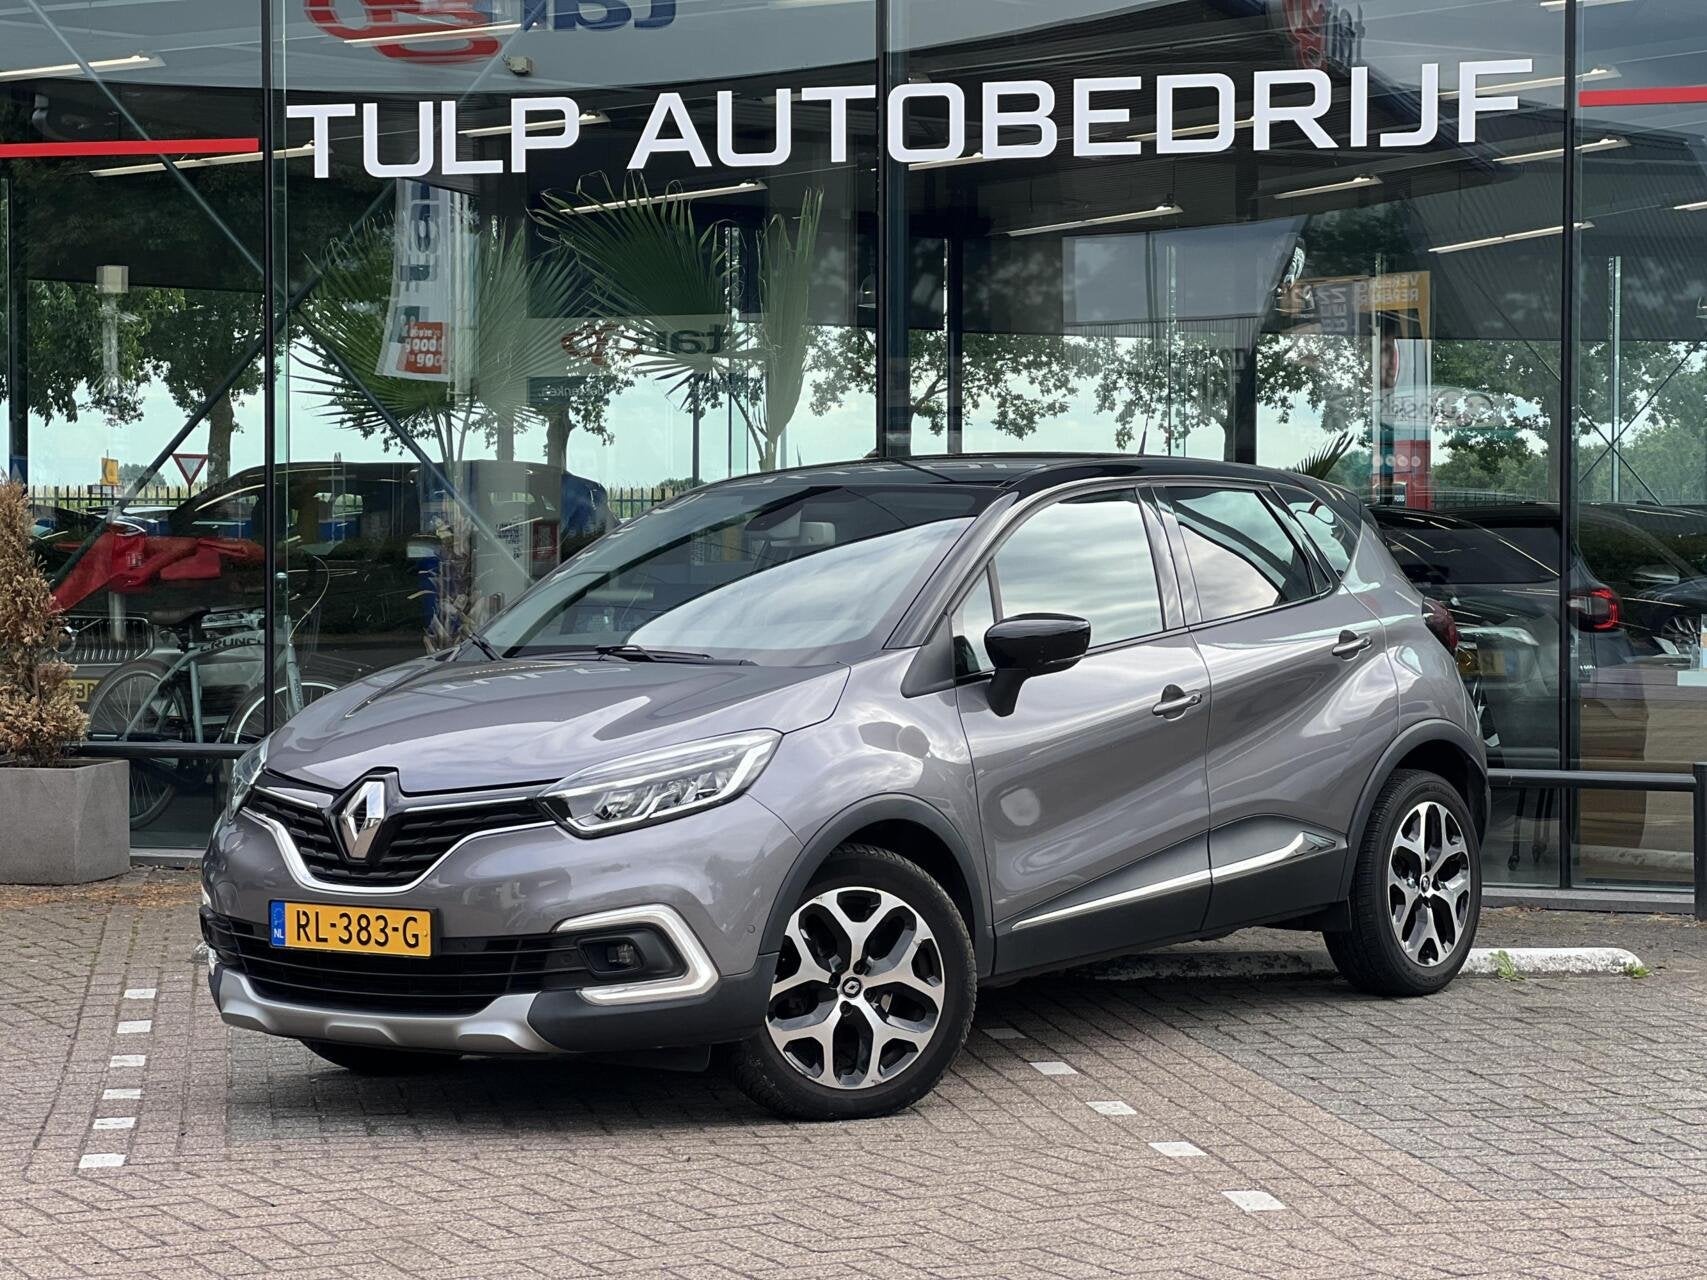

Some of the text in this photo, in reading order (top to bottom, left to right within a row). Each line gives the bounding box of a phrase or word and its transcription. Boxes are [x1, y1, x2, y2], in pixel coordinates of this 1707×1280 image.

[286, 59, 1533, 178] TULP AUTOBEDRIJF
[273, 928, 284, 939] NL
[296, 909, 420, 949] RL-383-G
